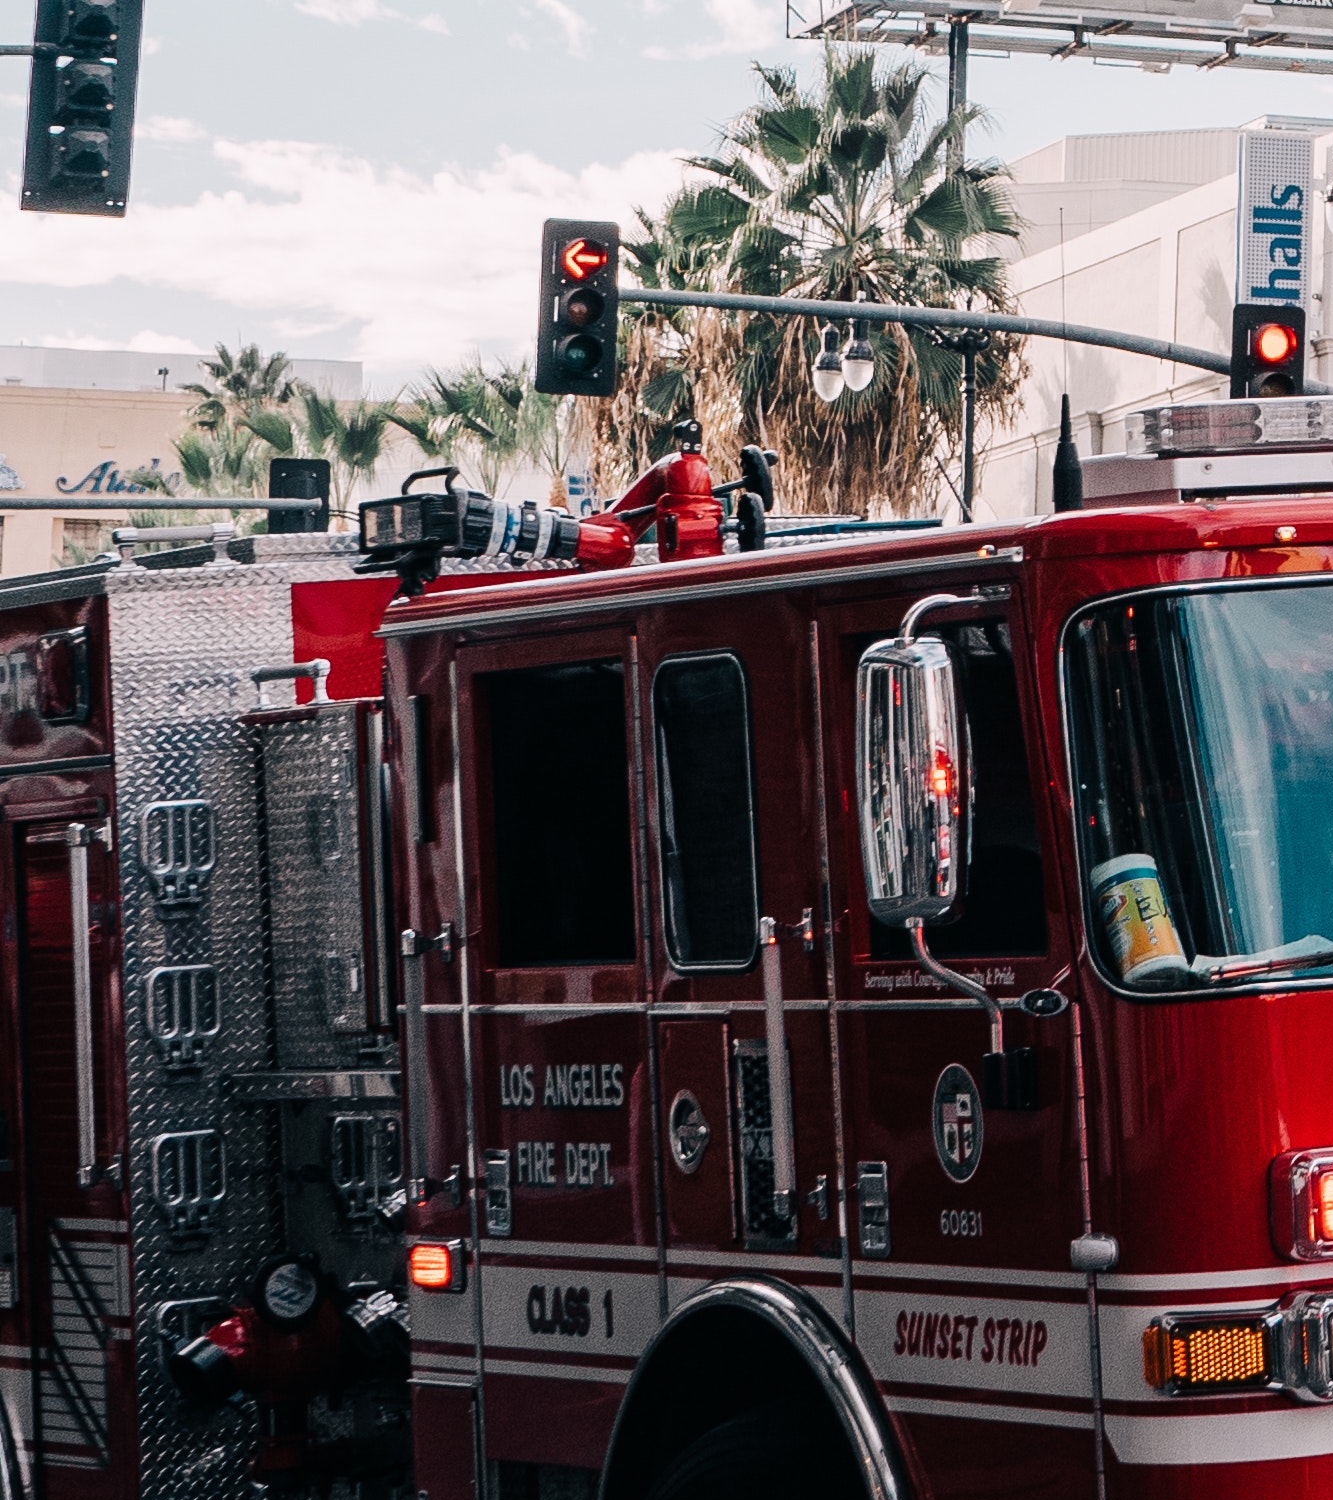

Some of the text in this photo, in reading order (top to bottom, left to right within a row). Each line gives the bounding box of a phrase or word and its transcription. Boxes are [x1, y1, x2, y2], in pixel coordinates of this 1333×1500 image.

[500, 1063, 624, 1107] LOS ANGELES
[517, 1141, 615, 1186] FIRE DEPT.
[941, 1209, 983, 1237] 60831
[526, 1284, 592, 1338] CLASS
[893, 1309, 1048, 1368] SUNSET STRIP
